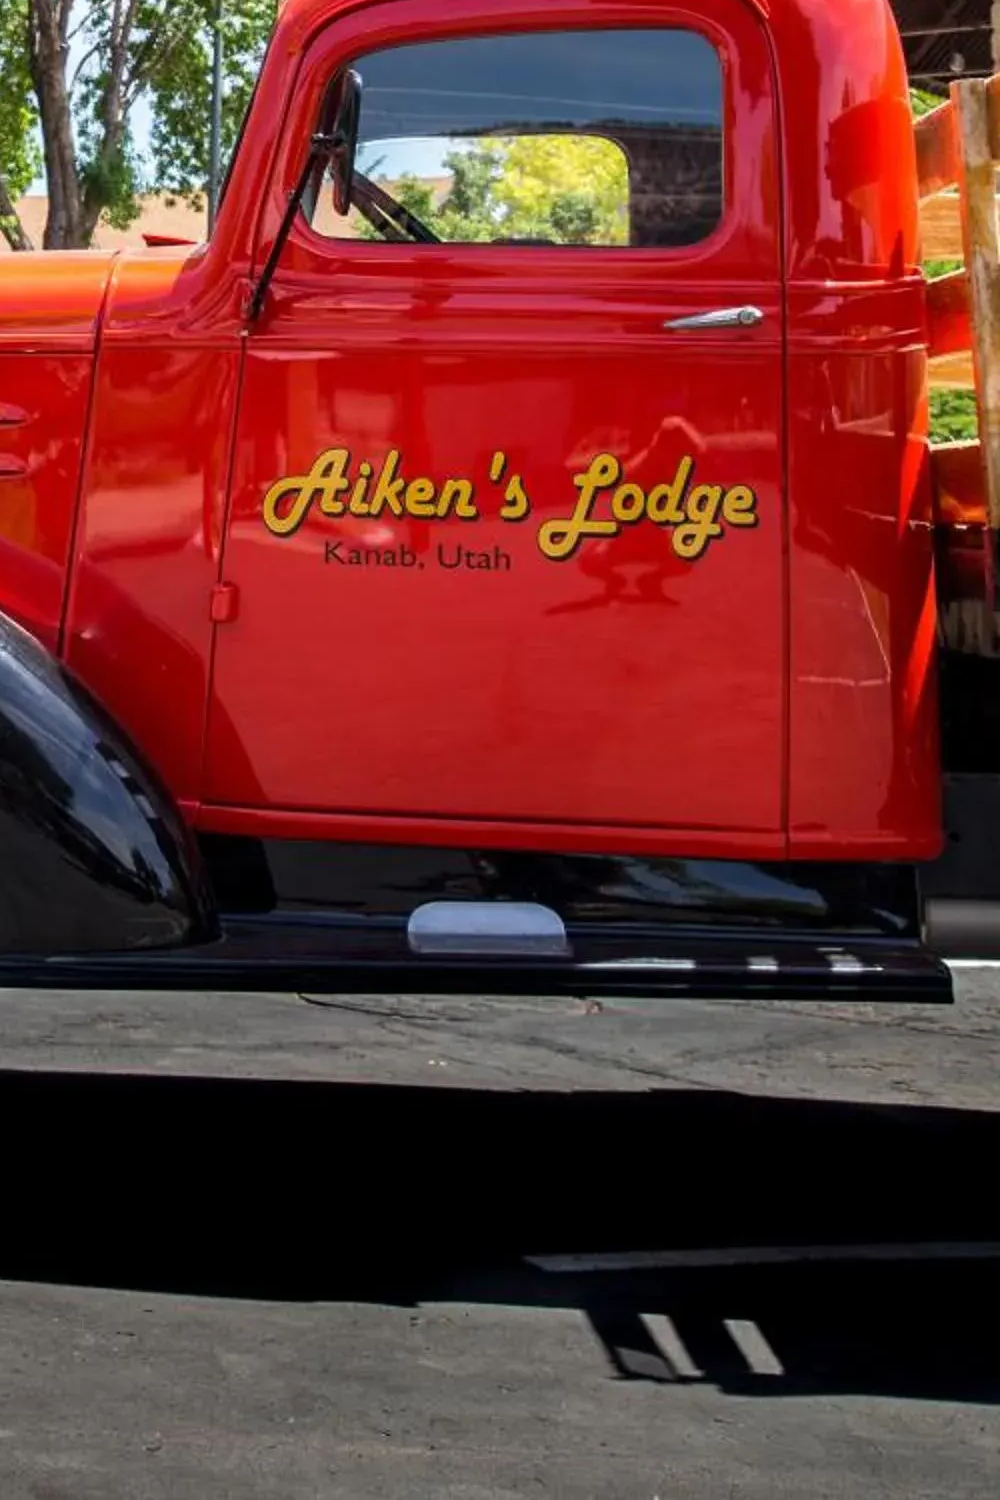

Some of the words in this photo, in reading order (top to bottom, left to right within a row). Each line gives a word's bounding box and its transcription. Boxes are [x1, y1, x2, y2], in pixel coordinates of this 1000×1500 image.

[263, 448, 532, 534] Aiken's
[537, 452, 757, 560] Lodge
[324, 541, 426, 571] Kanab,
[437, 543, 511, 571] Utah
